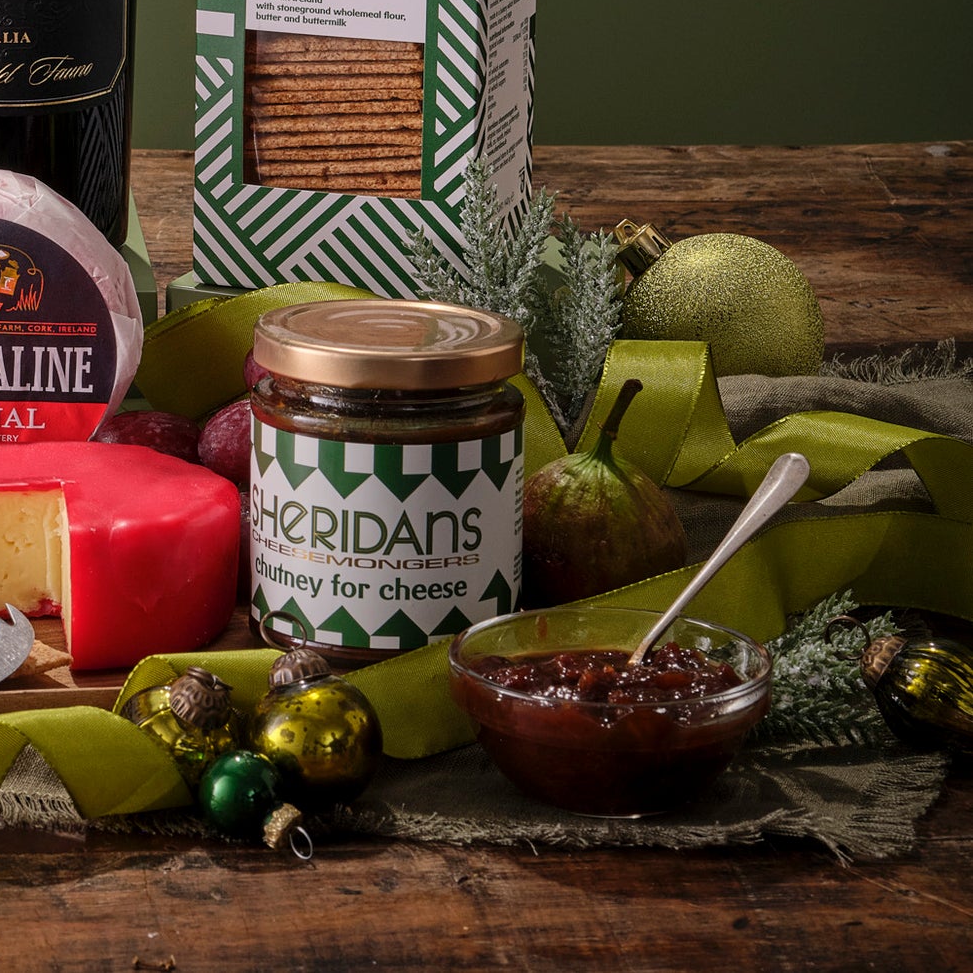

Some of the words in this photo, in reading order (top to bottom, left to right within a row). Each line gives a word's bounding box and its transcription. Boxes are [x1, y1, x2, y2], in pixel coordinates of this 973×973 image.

[256, 3, 274, 12] with
[277, 4, 331, 17] stoneground
[333, 7, 381, 19] wholemeal
[384, 10, 407, 21] flour,
[256, 13, 283, 23] butter
[286, 15, 304, 24] and
[307, 15, 347, 27] buttermilk
[29, 54, 94, 86] Fauno
[27, 325, 56, 333] CORK,
[58, 326, 97, 334] IRELAND
[252, 530, 481, 570] CHEESEMONGERS
[255, 554, 324, 599] chutney
[330, 573, 371, 600] for
[379, 577, 468, 602] cheese
